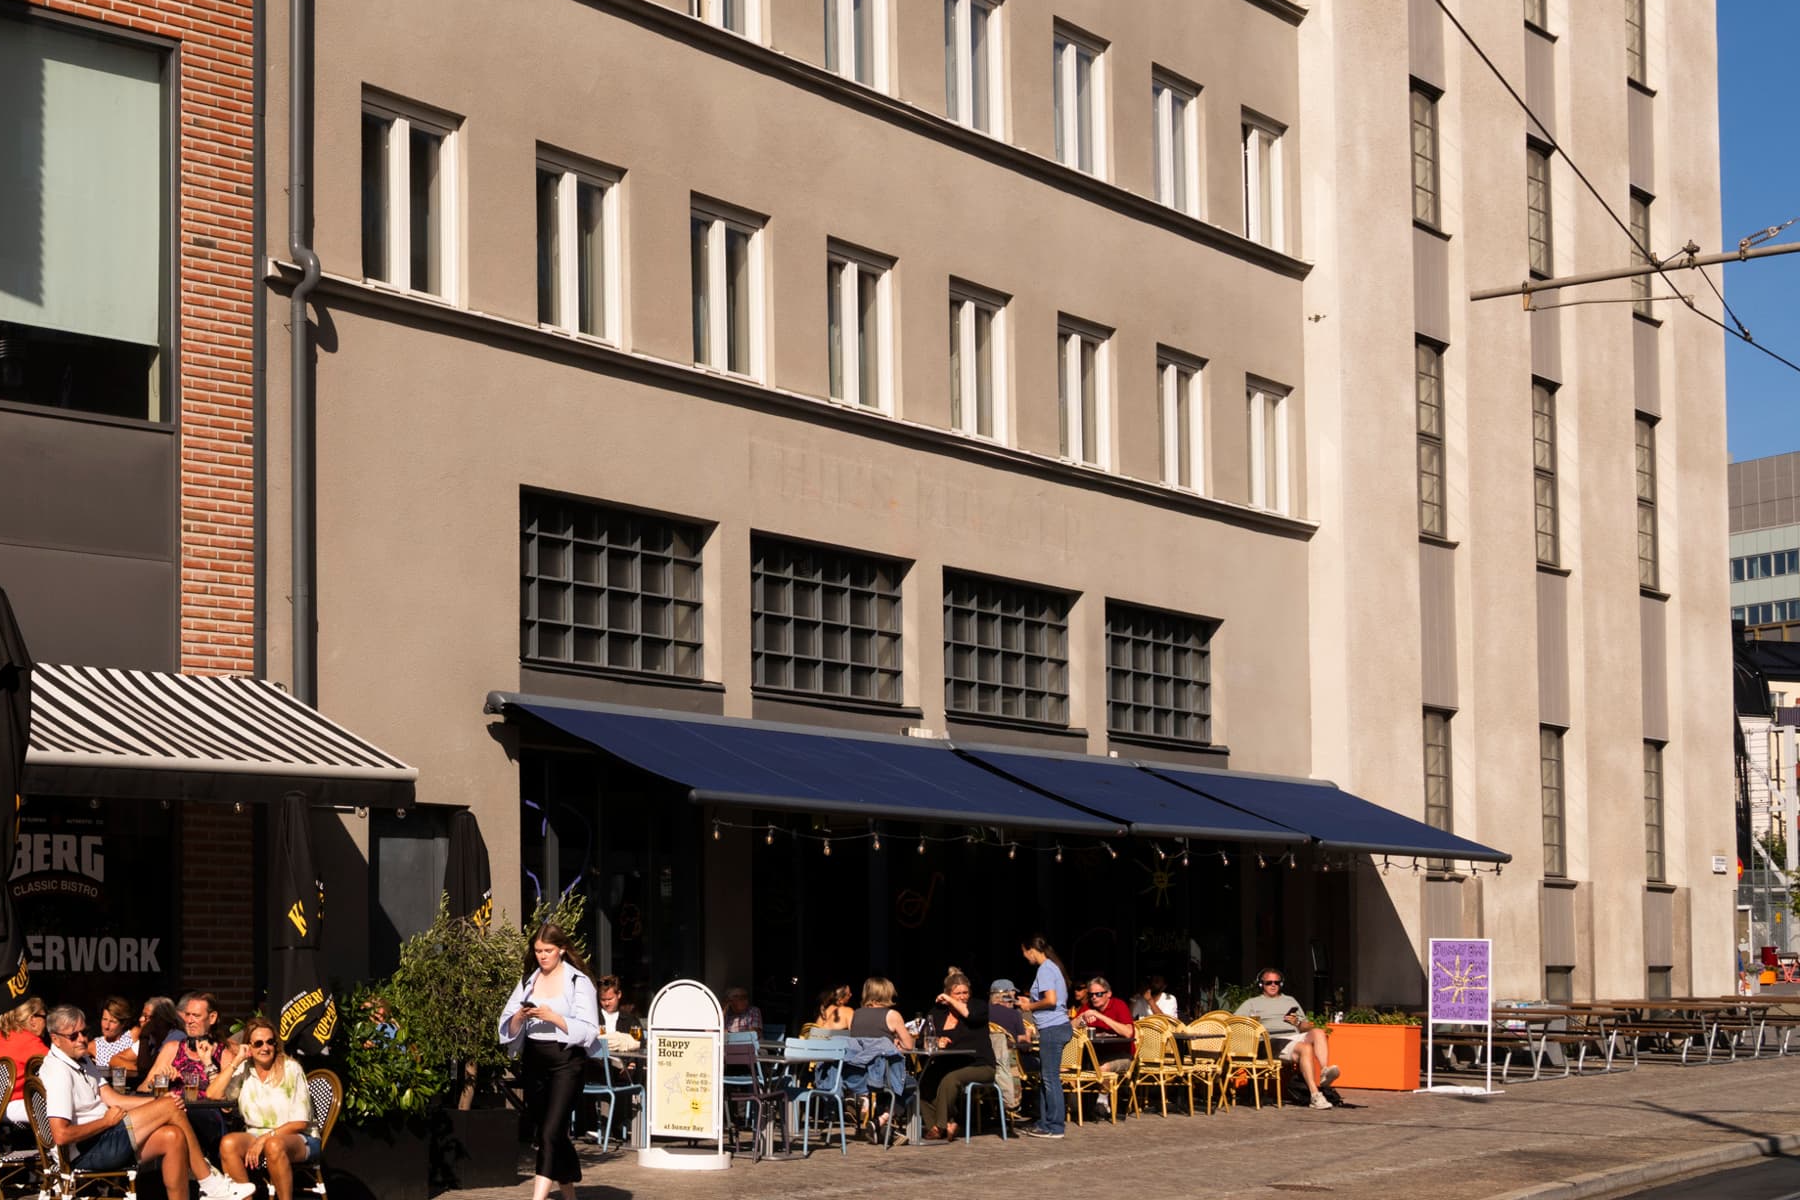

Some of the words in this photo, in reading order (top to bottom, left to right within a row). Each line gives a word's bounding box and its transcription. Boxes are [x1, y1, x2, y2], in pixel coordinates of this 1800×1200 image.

[7, 833, 105, 882] BERG
[13, 879, 58, 897] CLASSIC
[60, 879, 99, 898] BISTRO
[25, 935, 161, 973] ERWORK
[658, 1038, 690, 1050] Happy
[658, 1047, 684, 1058] Hour
